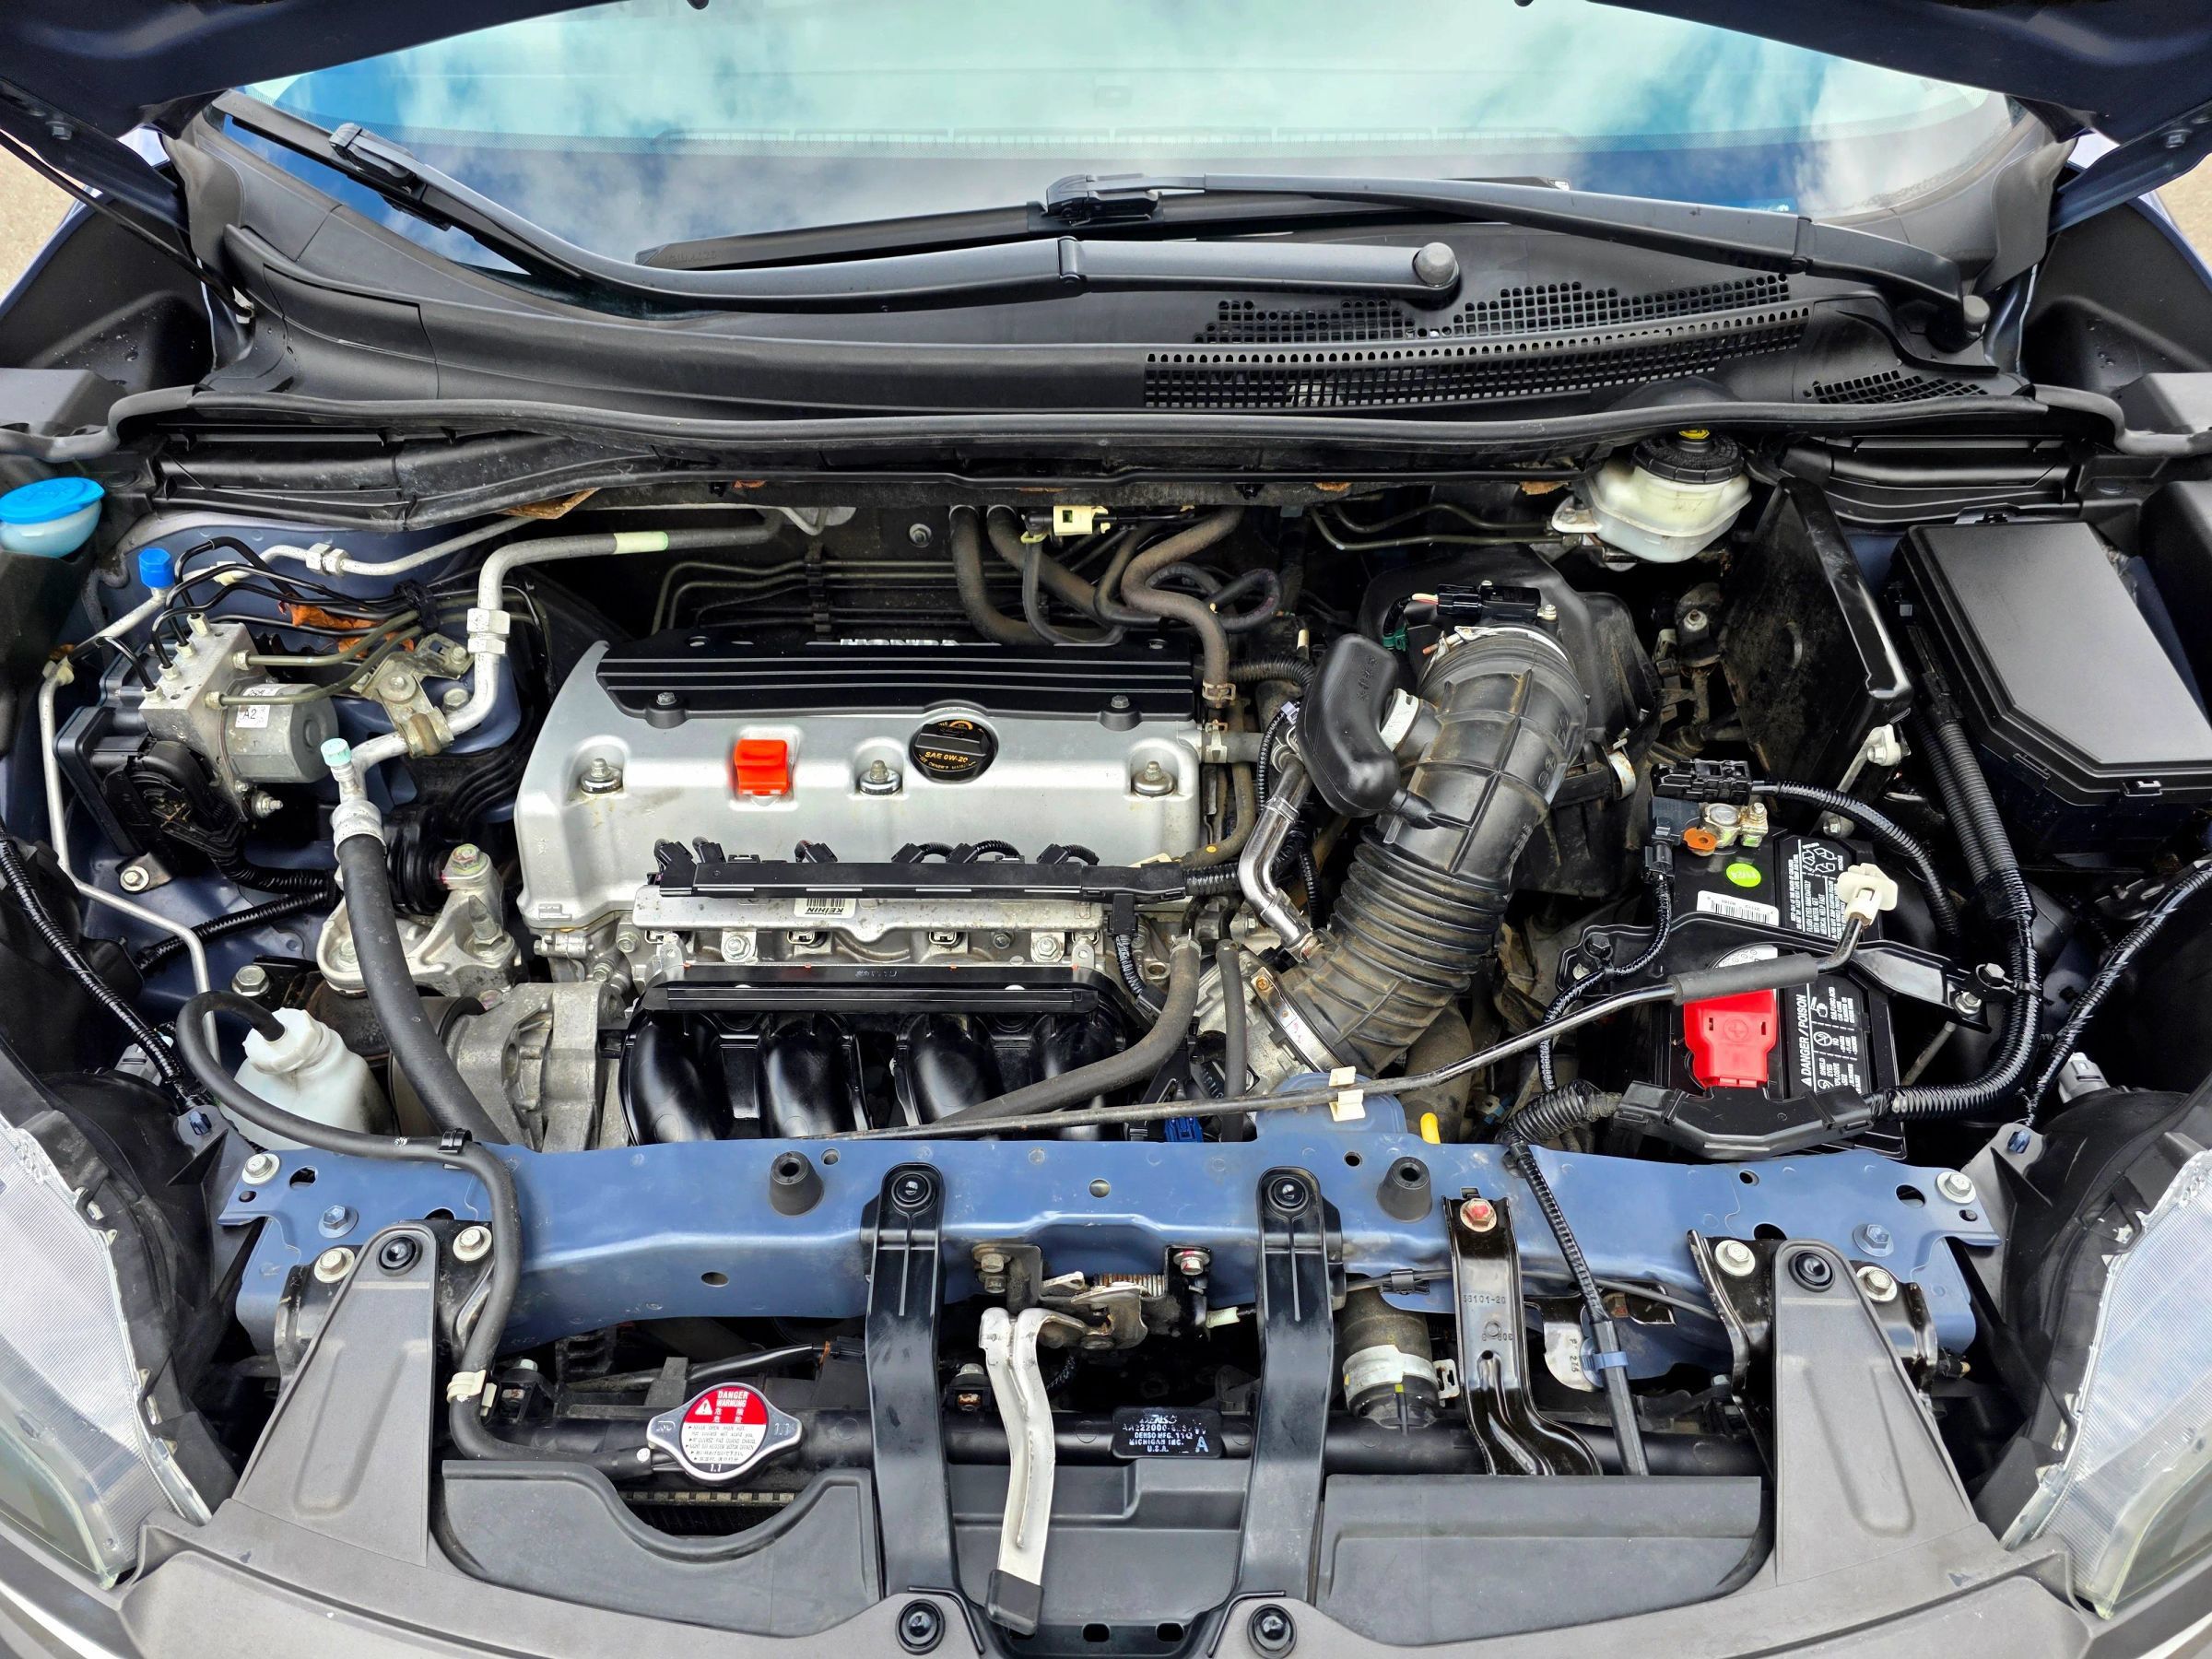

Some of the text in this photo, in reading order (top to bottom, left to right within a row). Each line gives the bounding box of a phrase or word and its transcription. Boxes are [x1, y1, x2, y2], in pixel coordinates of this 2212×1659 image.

[924, 751, 969, 763] SAE 0W-20
[1796, 994, 1808, 1029] POISON
[1799, 1037, 1812, 1077] DANGER
[717, 1390, 749, 1399] DANGER
[1194, 1436, 1209, 1453] A
[710, 1464, 722, 1472] 1.1
